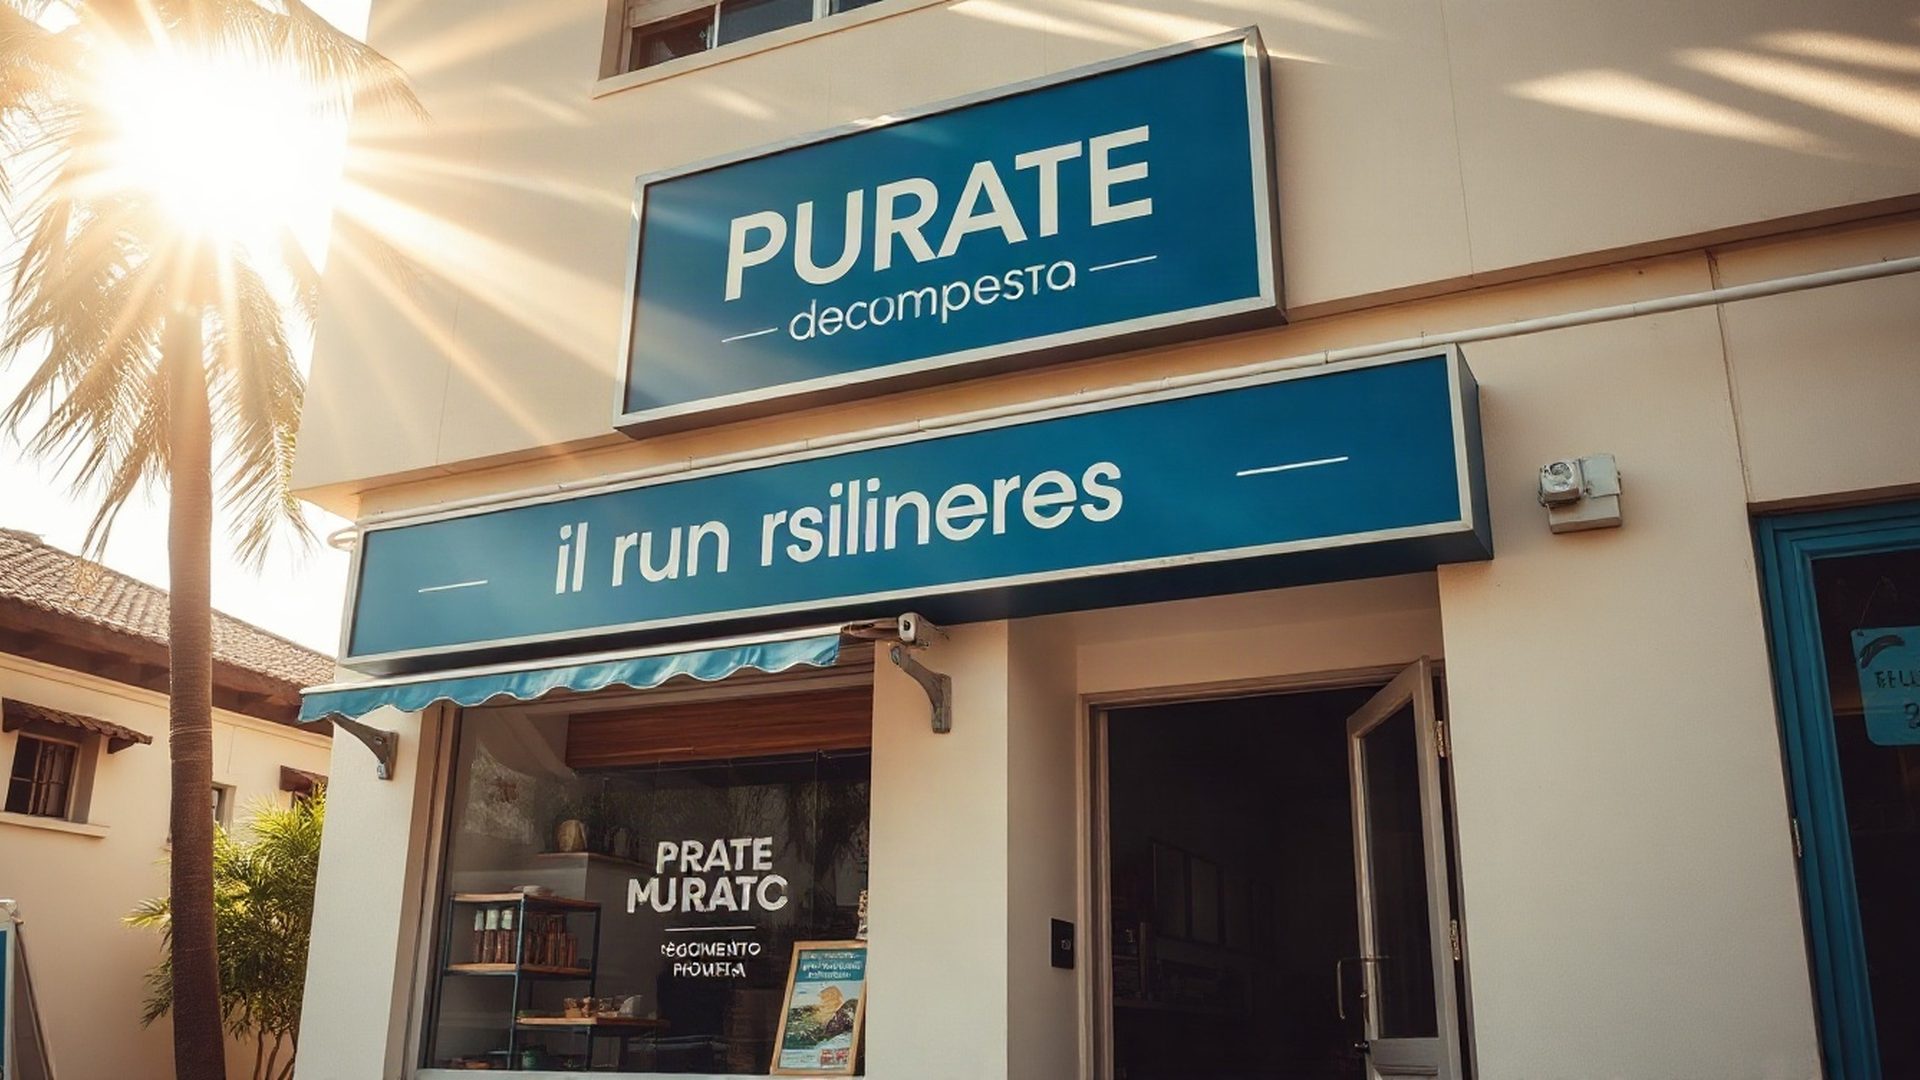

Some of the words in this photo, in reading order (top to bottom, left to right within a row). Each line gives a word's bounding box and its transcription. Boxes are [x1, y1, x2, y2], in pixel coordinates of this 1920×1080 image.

[724, 125, 1153, 301] PURATE
[555, 522, 588, 595] il
[611, 520, 730, 587] run
[761, 461, 1123, 568] rsilineres
[656, 836, 773, 874] PRATE
